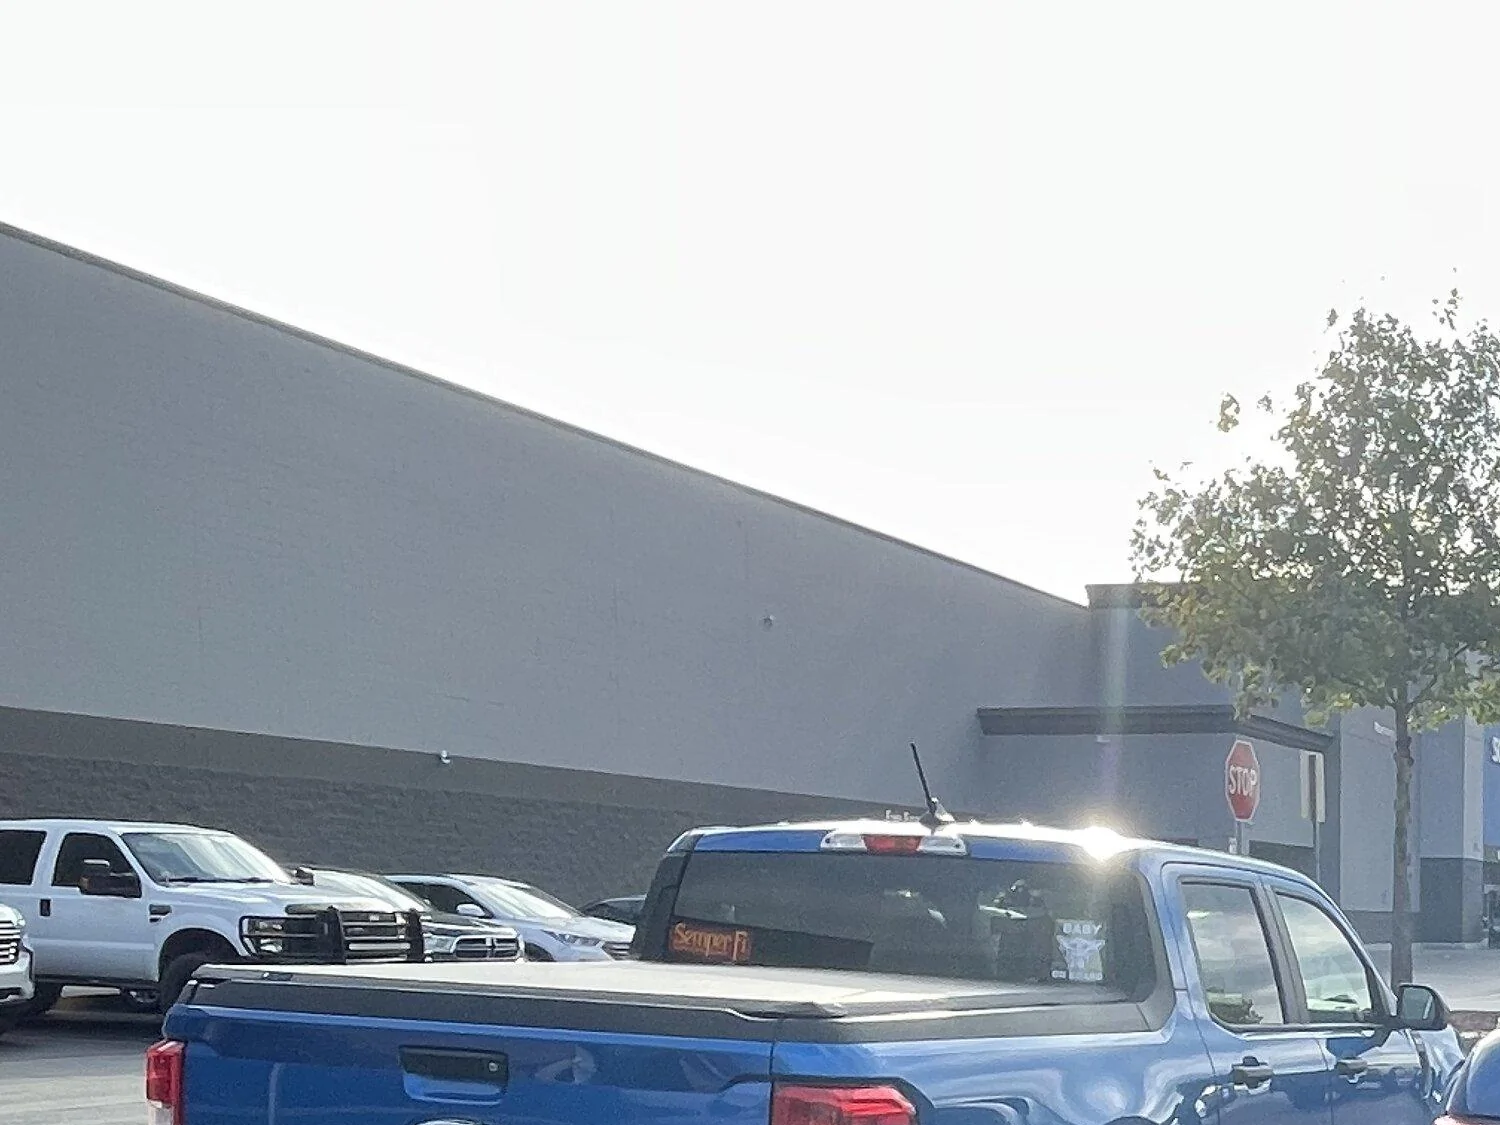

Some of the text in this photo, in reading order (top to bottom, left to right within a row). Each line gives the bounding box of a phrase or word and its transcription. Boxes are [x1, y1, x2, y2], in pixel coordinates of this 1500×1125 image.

[1229, 764, 1258, 797] STOP
[674, 922, 749, 961] Semper Fi
[1062, 922, 1102, 935] BABY
